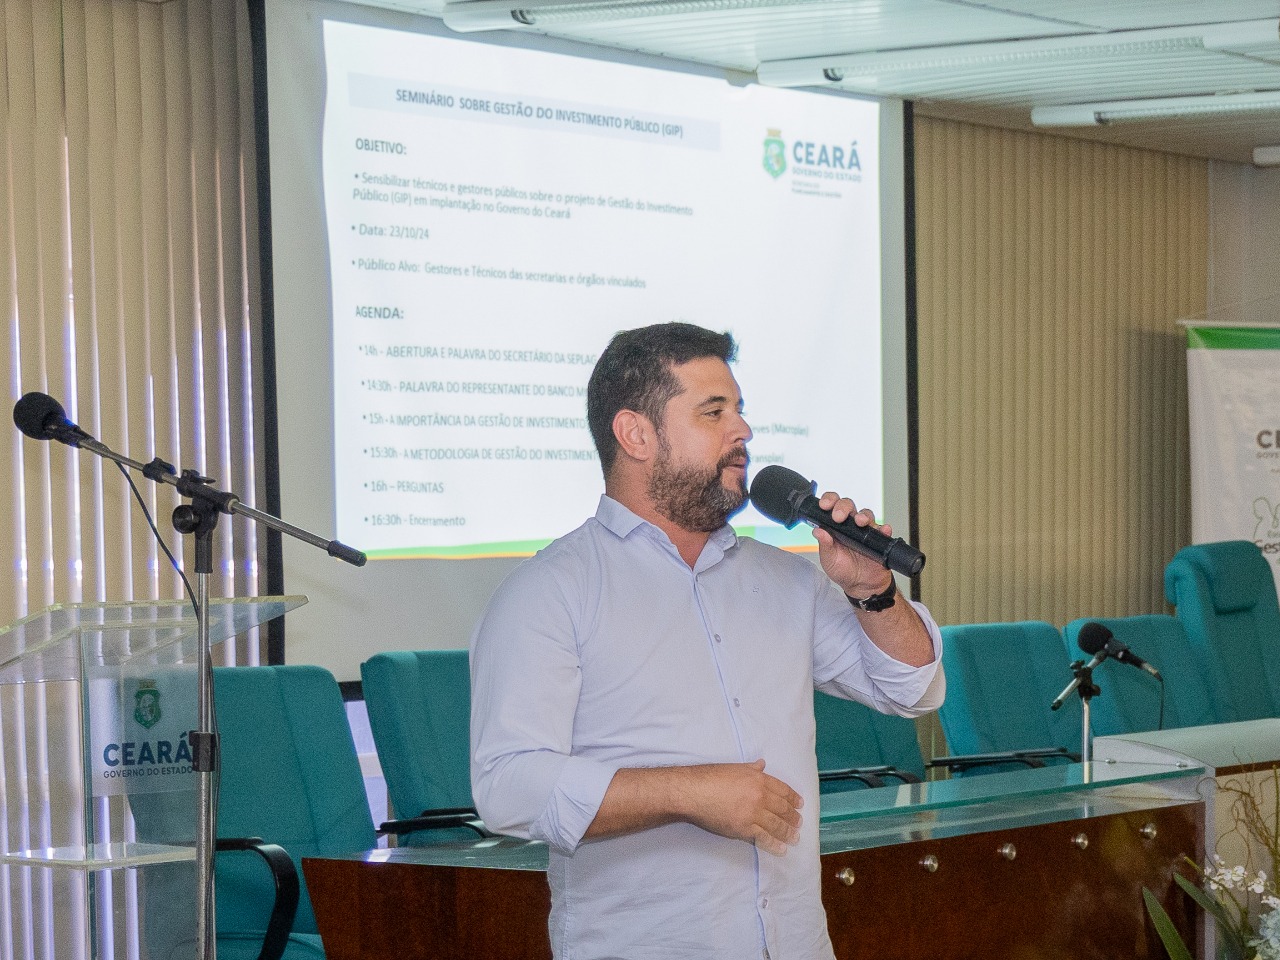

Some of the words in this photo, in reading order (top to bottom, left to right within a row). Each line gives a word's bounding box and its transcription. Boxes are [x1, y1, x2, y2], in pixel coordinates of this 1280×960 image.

[396, 89, 454, 108] SEMINÁRIO
[460, 97, 491, 113] SOBRE
[493, 101, 533, 118] GESTÃO
[536, 106, 553, 120] DO
[556, 109, 622, 129] INVESTIMENTO
[624, 116, 660, 134] PÚBLICO
[662, 123, 683, 140] (GIP)
[355, 137, 407, 156] OBJETIVO:
[793, 140, 861, 171] CEARÁ
[361, 171, 410, 188] Sensibilizar
[412, 178, 448, 192] técnicos
[450, 183, 456, 192] e
[457, 184, 494, 196] gestores
[495, 186, 527, 199] públicos
[528, 190, 553, 202] sobre
[556, 194, 563, 202] o
[565, 194, 596, 207] projeto
[597, 195, 606, 206] de
[608, 196, 634, 210] Gestão
[635, 199, 646, 211] do
[647, 201, 694, 217] Investimento
[352, 188, 389, 203] Público
[391, 191, 411, 206] (GIP)
[413, 195, 428, 206] em
[430, 197, 481, 213] implantação
[483, 201, 494, 212] no
[496, 201, 531, 216] Governo
[532, 205, 543, 217] do
[544, 206, 571, 219] Ceará
[359, 223, 388, 237] Data:
[389, 225, 430, 240] 23/10/24
[358, 257, 396, 272] Público
[398, 260, 421, 273] Alvo:
[424, 261, 463, 276] Gestores
[464, 267, 470, 276] e
[471, 265, 508, 279] Técnicos
[509, 268, 524, 280] das
[525, 271, 567, 284] secretarias
[569, 274, 575, 284] e
[577, 272, 605, 288] órgãos
[607, 275, 647, 289] vinculados
[355, 304, 405, 320] AGENDA:
[364, 344, 379, 357] 14h
[386, 345, 439, 358] ABERTURA
[440, 346, 447, 359] E
[448, 347, 486, 361] PALAVRA
[488, 349, 501, 361] DO
[503, 349, 552, 363] SECRETÁRIO
[554, 352, 566, 364] DA
[399, 380, 445, 393] PALAVRA
[446, 381, 460, 393] DO
[462, 382, 531, 396] REPRESENTANTE
[532, 384, 546, 396] DO
[547, 385, 575, 398] BANCO
[369, 412, 384, 425] 15h
[396, 411, 461, 427] IMPORTÂNCIA
[463, 414, 476, 427] DA
[478, 412, 511, 427] GESTÃO
[513, 415, 524, 428] DE
[526, 416, 587, 429] INVESTIMENTO
[371, 446, 398, 459] 15:30h
[404, 448, 409, 459] A
[410, 448, 479, 460] METODOLOGIA
[481, 448, 493, 460] DE
[494, 445, 527, 461] GESTÃO
[530, 449, 542, 461] DO
[371, 480, 388, 492] 16h
[397, 480, 444, 494] PERGUNTAS
[372, 513, 402, 526] 16:30h
[409, 513, 466, 527] Encerramento
[103, 731, 194, 767] CEARÁ
[103, 768, 145, 778] GOVERNO
[147, 768, 160, 776] DO
[161, 766, 194, 775] ESTADO
